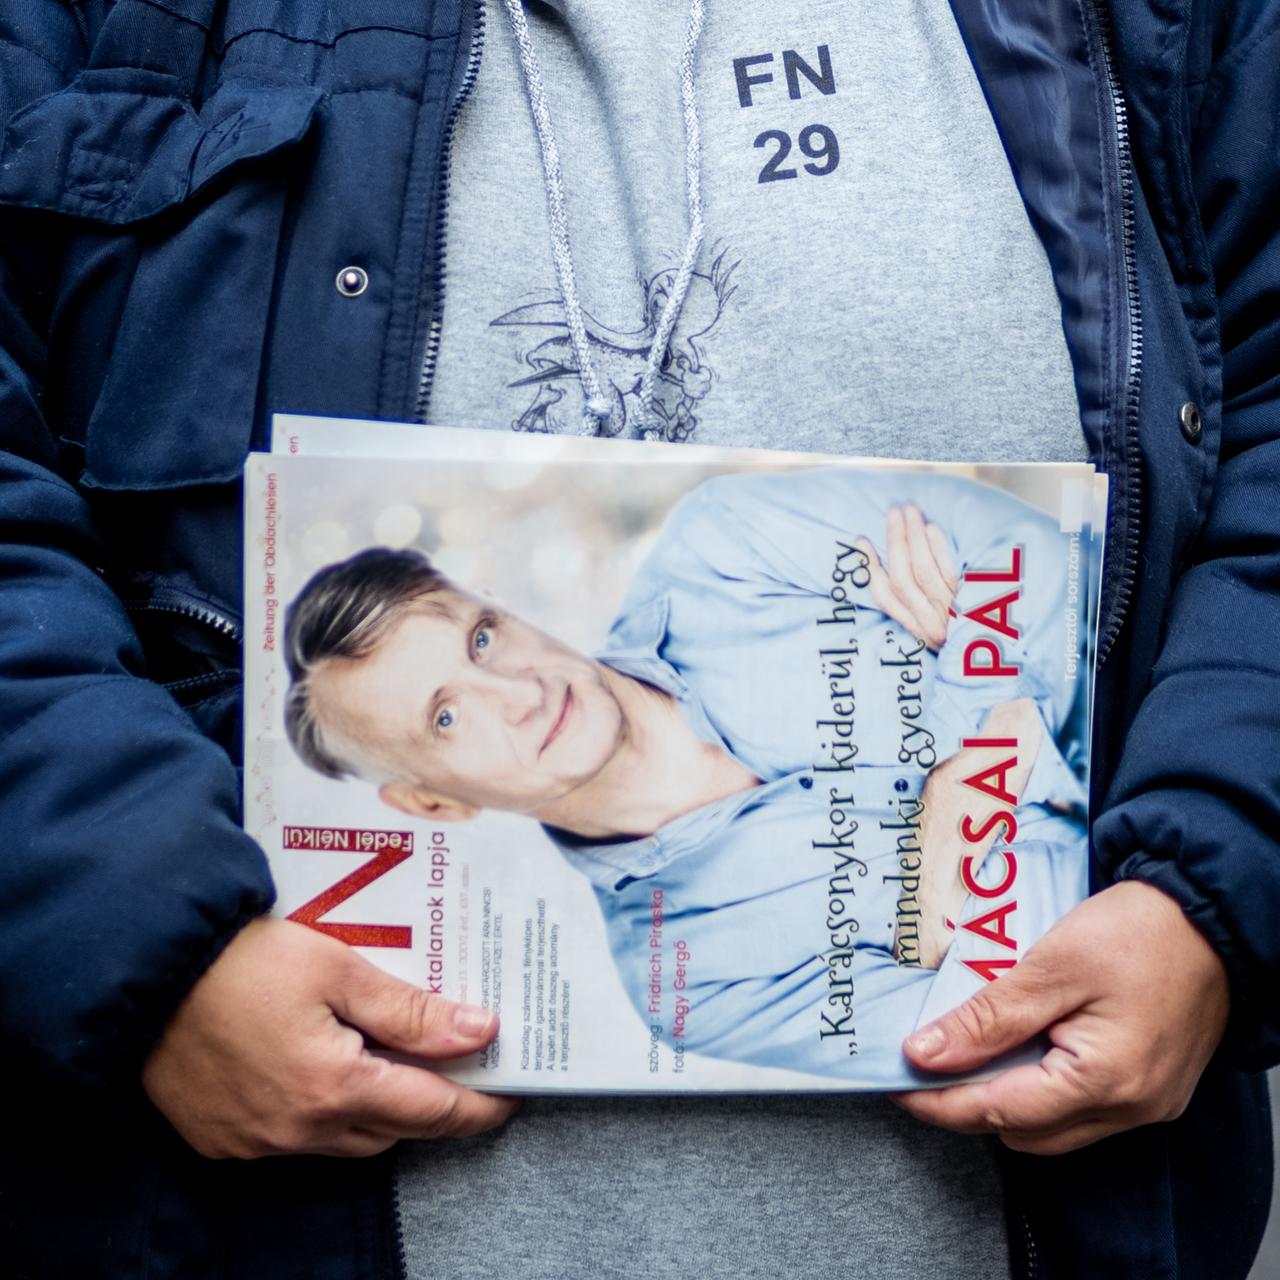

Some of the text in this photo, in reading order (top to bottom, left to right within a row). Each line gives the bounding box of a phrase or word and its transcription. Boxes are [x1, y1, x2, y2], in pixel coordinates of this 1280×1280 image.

[732, 44, 837, 108] FN
[753, 123, 841, 184] 29
[263, 473, 278, 651] Zeitung der Obdachlosen
[816, 541, 870, 626] hogy
[948, 548, 1021, 677] PÁL
[1064, 608, 1080, 682] Terjesztői
[812, 638, 859, 774] kiderül,
[880, 630, 936, 966] mindenki gyerek”
[284, 828, 413, 852] Fedél Nélkül
[425, 831, 450, 994] ktalanok lapja
[648, 889, 664, 948] Piroska
[648, 953, 662, 1014] Fridrich
[673, 940, 690, 992] Gergő
[672, 994, 690, 1038] Nagy
[546, 1063, 556, 1072] A
[648, 1024, 663, 1073] szöveg
